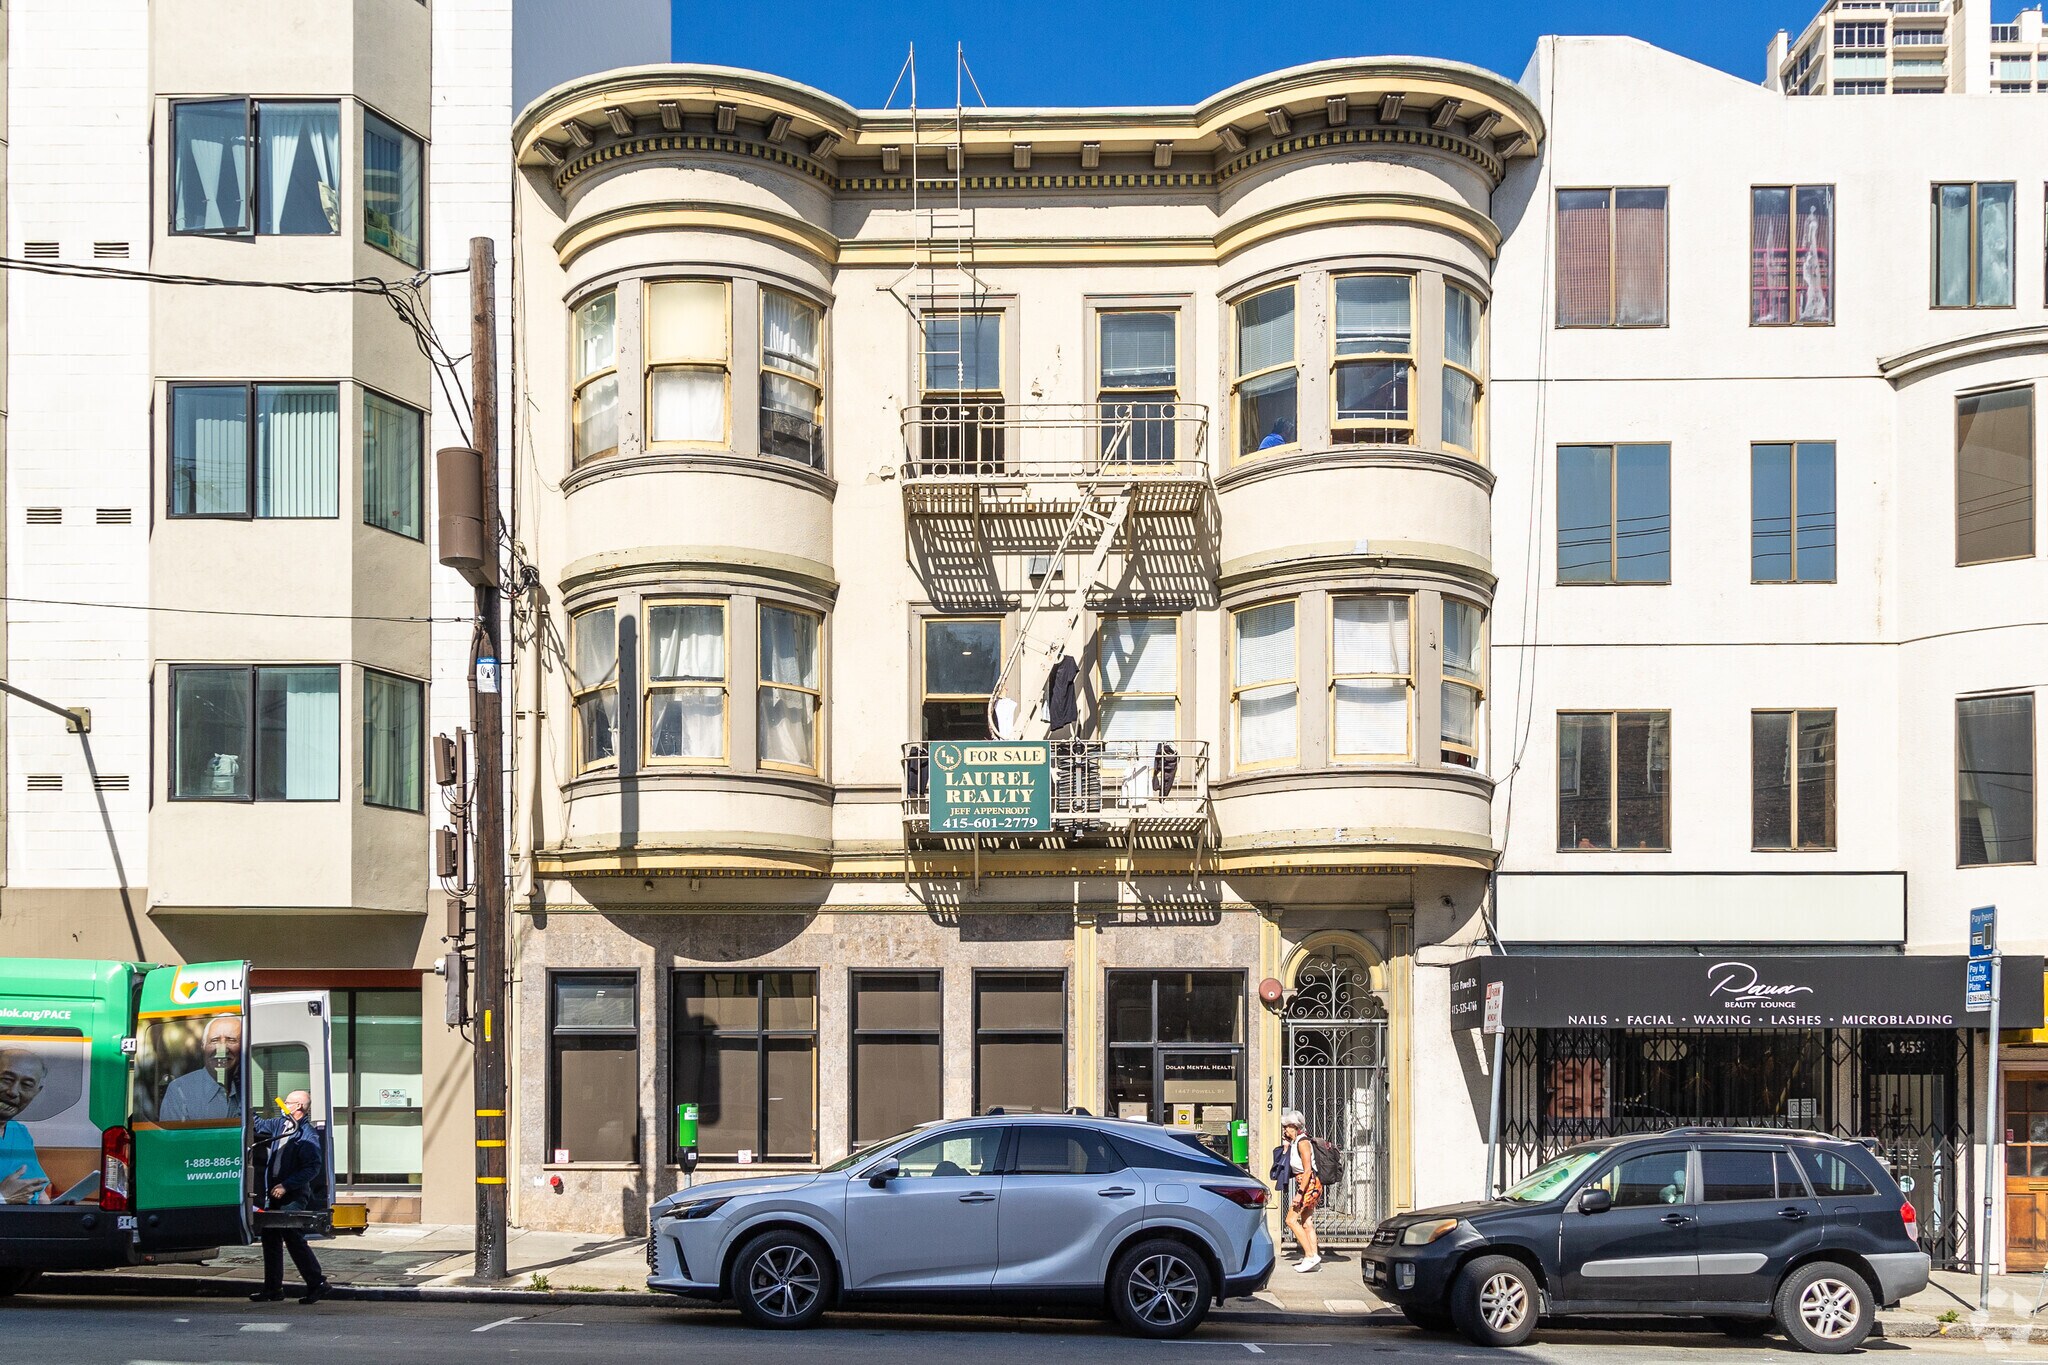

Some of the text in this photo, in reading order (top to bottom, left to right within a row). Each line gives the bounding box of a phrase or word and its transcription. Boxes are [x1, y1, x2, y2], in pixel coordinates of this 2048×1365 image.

[970, 751, 1041, 762] FOR SALE
[945, 771, 1036, 787] LAUREL
[946, 789, 1035, 804] REALTY
[950, 807, 1031, 816] JEFF APPENRODT
[942, 817, 1038, 829] 415-601-2779
[1971, 911, 1994, 925] Pay here
[1969, 962, 1986, 974] Pay by
[1969, 974, 1986, 982] License
[231, 978, 243, 990] L
[1969, 982, 1981, 991] Plate
[1724, 1001, 1797, 1009] BEAUTY LOUNGE
[1568, 1014, 1954, 1025] NAILS FACIAL WAXING LASHES MICROBLADING
[184, 1157, 242, 1168] 1-888-886-6
